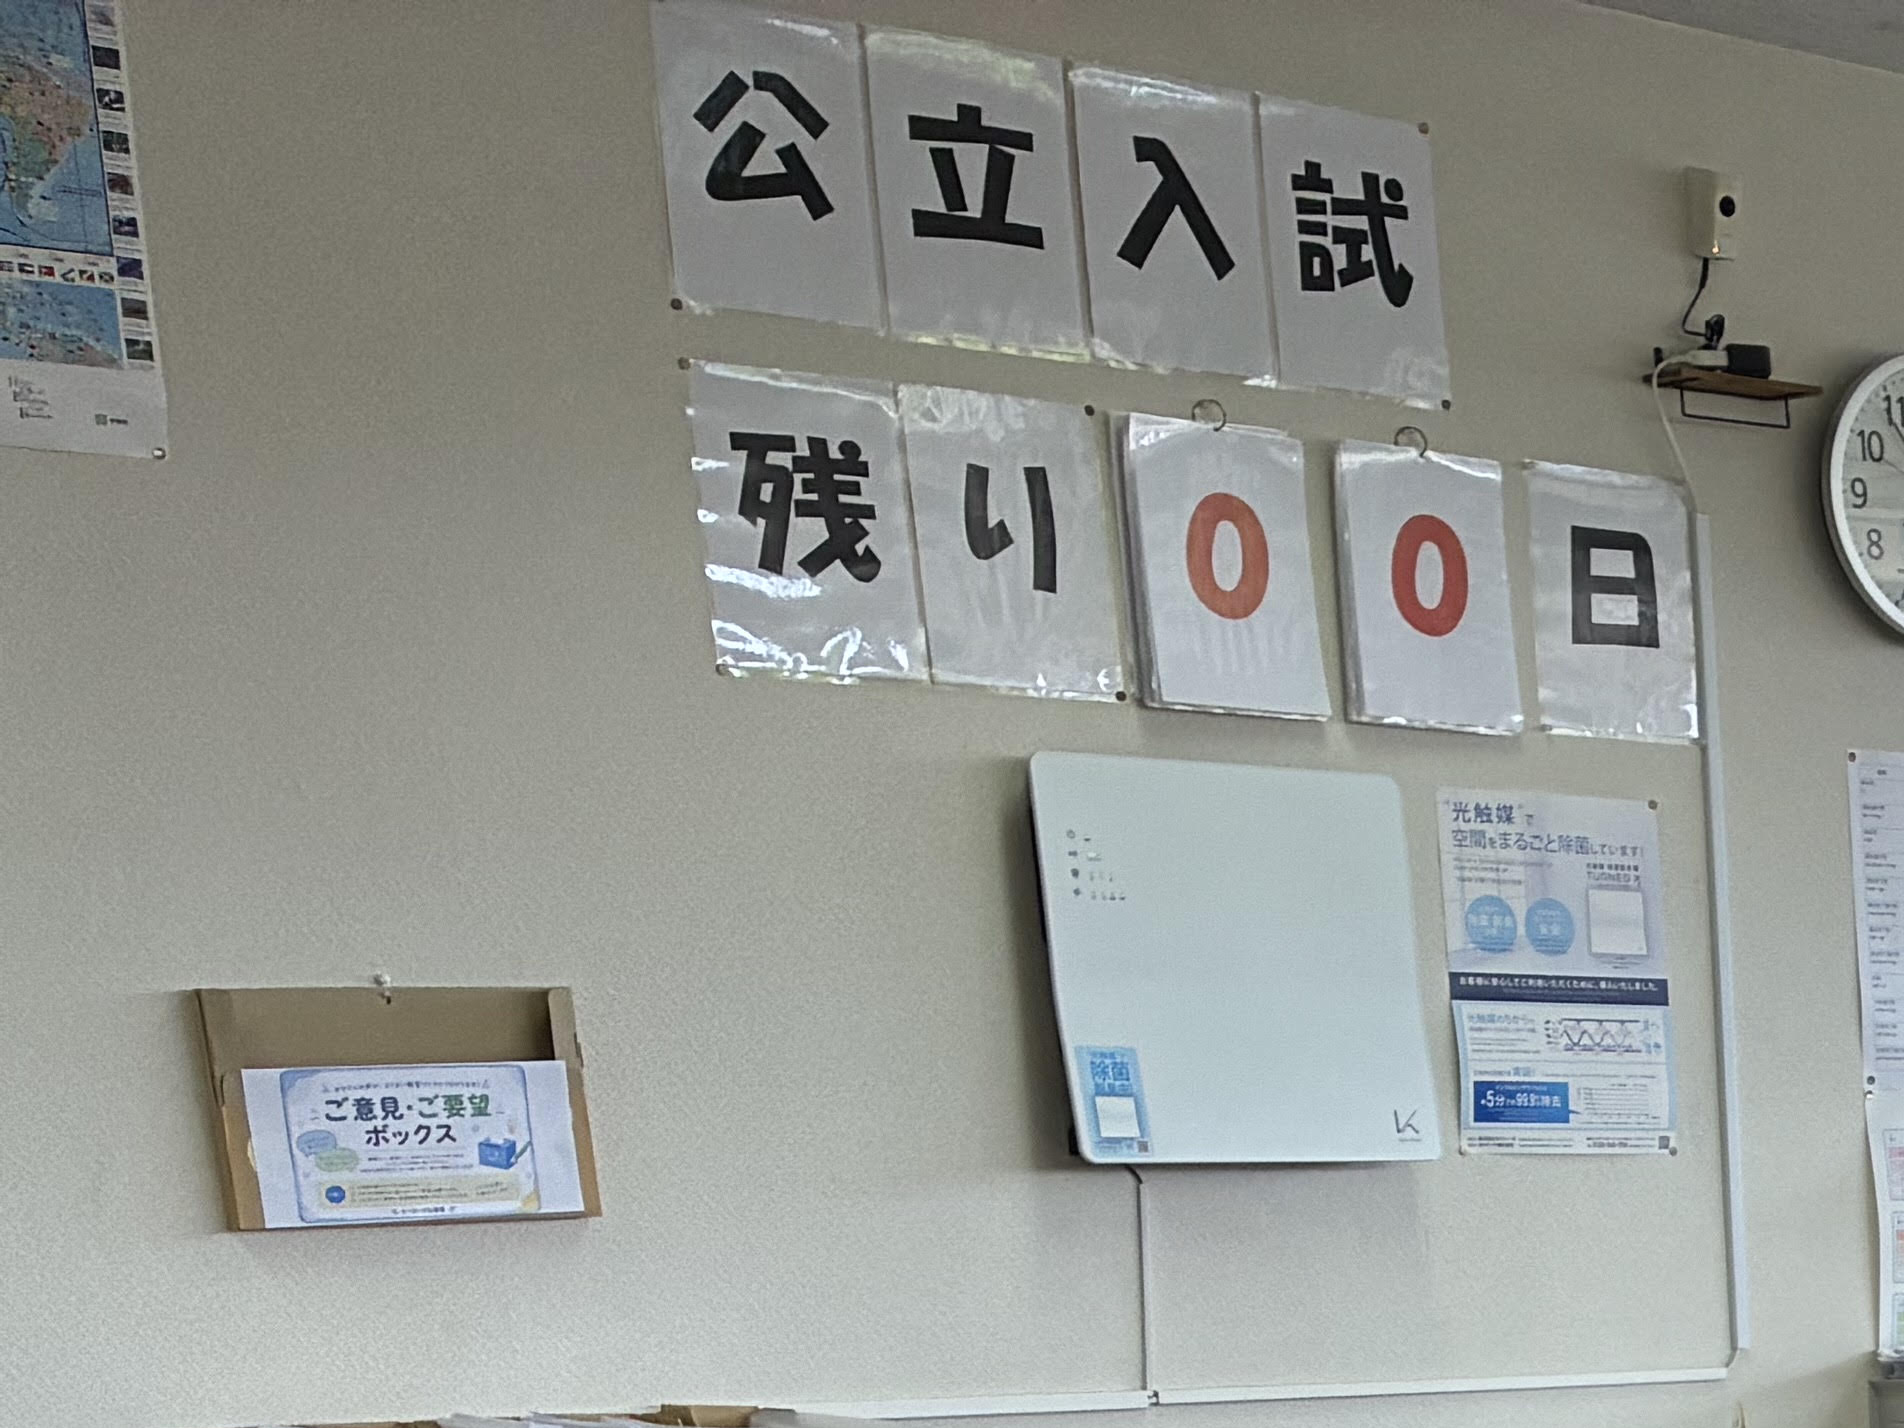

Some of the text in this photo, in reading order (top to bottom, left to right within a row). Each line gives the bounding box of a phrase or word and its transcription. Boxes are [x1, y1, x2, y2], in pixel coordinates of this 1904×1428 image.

[692, 70, 1415, 307] 公立入試
[1856, 429, 1885, 463] 10
[1850, 476, 1868, 509] 9
[729, 431, 1660, 650] 残り00日
[1866, 528, 1884, 560] 8
[324, 1093, 493, 1122] ご意見・ご要望
[365, 1124, 458, 1147] ボックス
